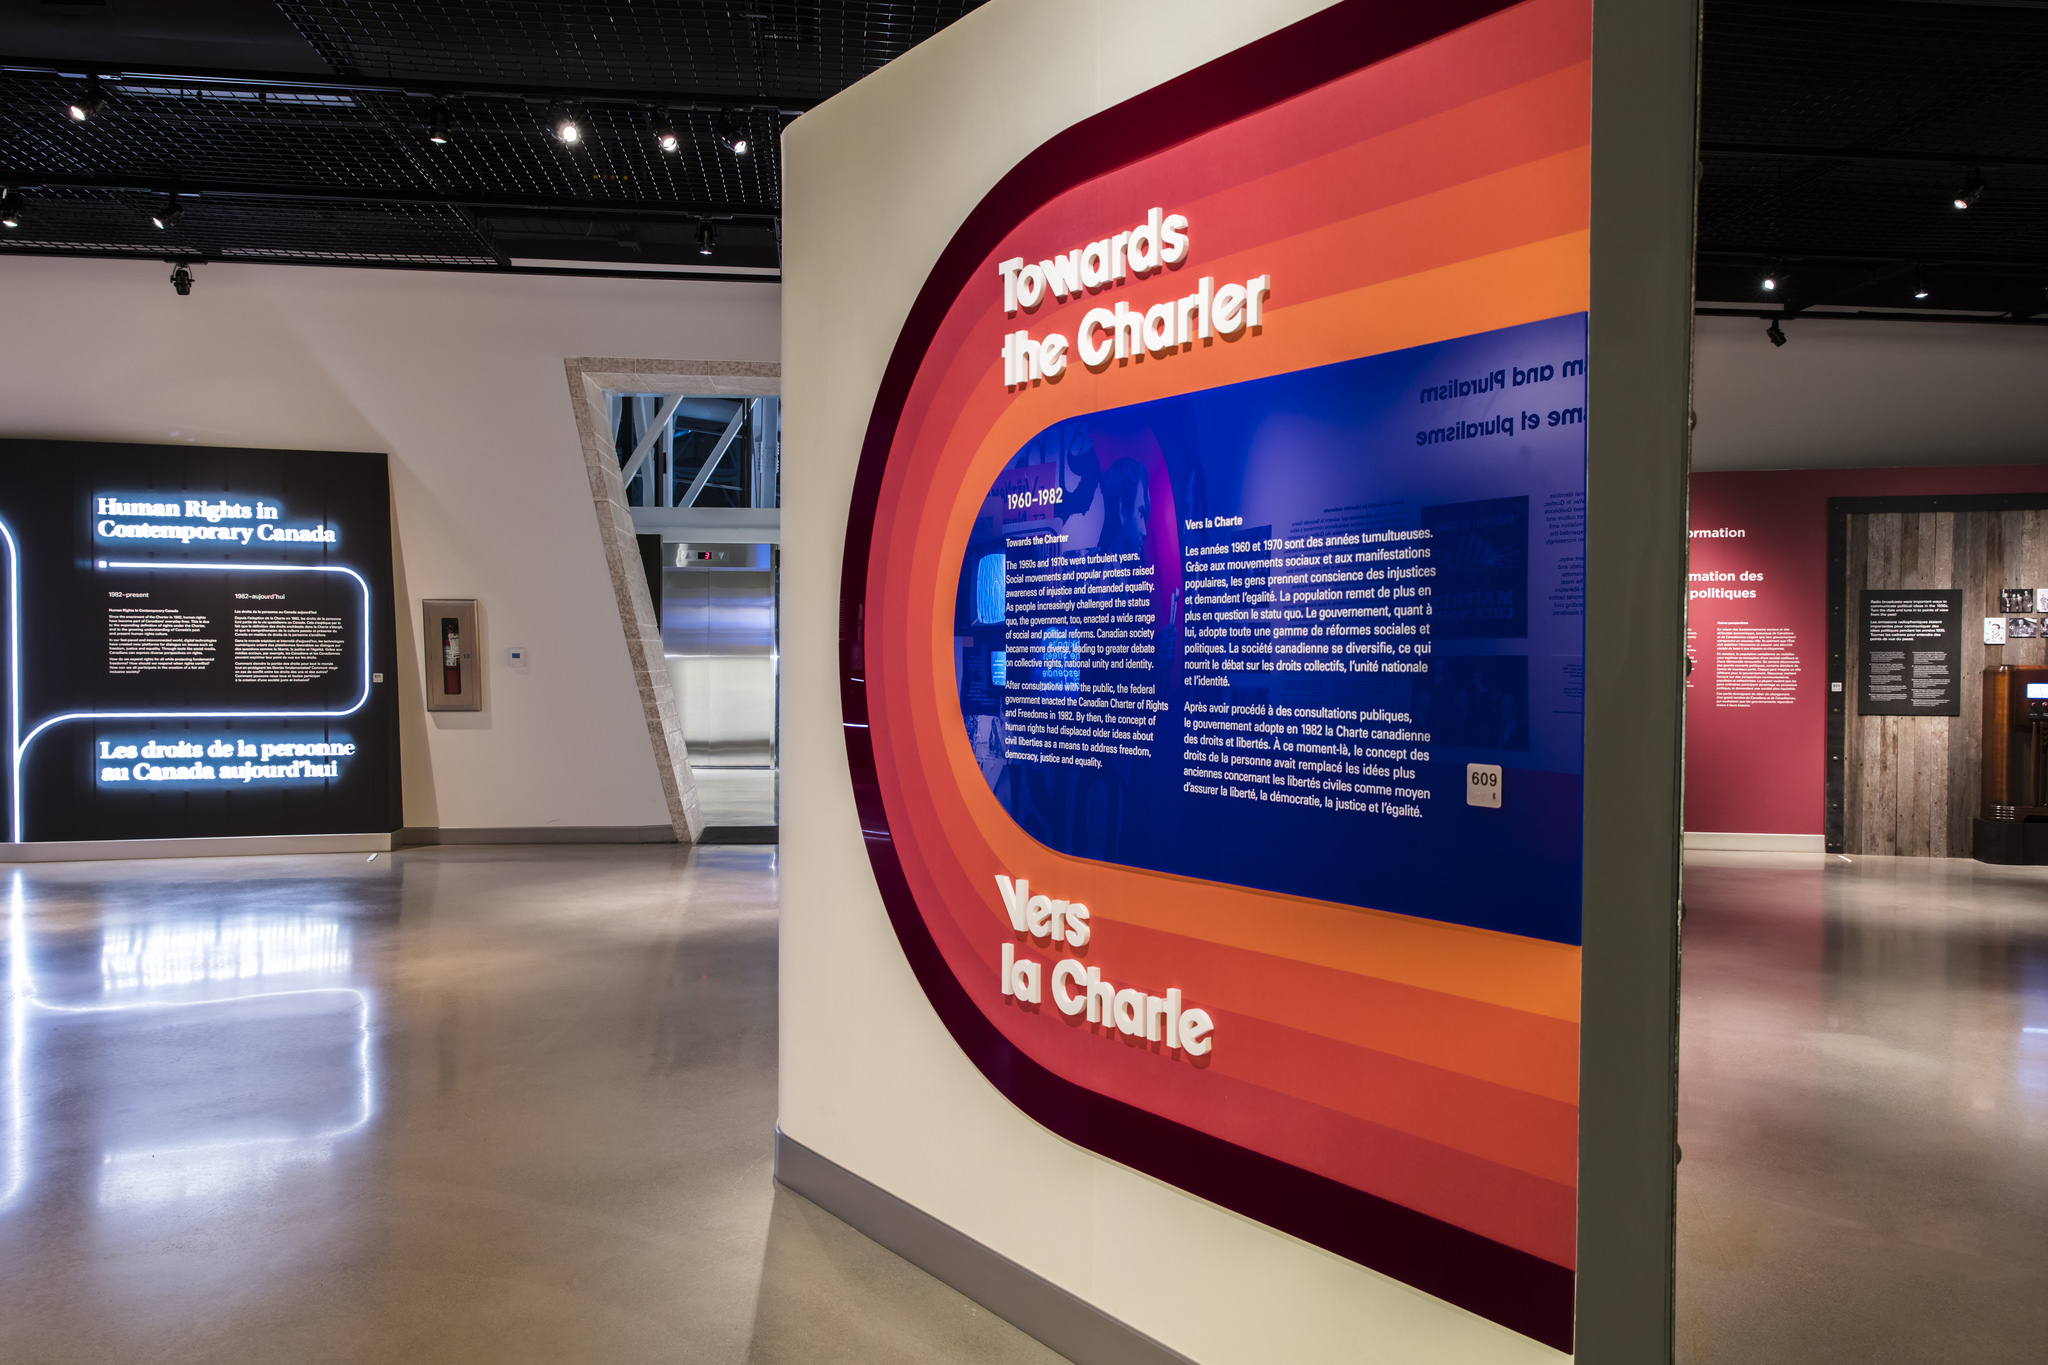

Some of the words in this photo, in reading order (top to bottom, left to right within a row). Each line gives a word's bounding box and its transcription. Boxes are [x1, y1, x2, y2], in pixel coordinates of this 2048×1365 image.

[998, 206, 1189, 313] Towards
[1001, 330, 1069, 386] the
[1077, 274, 1271, 366] Charter
[97, 498, 181, 517] Human
[184, 499, 252, 523] Rights
[255, 501, 279, 520] in
[1185, 519, 1203, 529] Vers
[1205, 518, 1212, 527] la
[1214, 515, 1242, 527] Charte
[97, 520, 254, 545] Contemporary
[256, 523, 337, 543] Canada
[1006, 536, 1031, 547] Towards
[1032, 535, 1043, 544] the
[1044, 534, 1068, 543] Charter
[1185, 546, 1198, 556] Les
[1200, 543, 1228, 554] années
[1231, 541, 1250, 552] 1960
[1252, 541, 1260, 551] et
[1263, 538, 1282, 550] 1970
[1284, 538, 1304, 549] sont
[1306, 536, 1323, 547] des
[1325, 533, 1359, 546] années
[1362, 529, 1432, 543] tumultueuses.
[704, 551, 710, 560] 3
[1006, 560, 1017, 570] The
[1019, 559, 1035, 568] 1960s
[1037, 557, 1049, 567] and
[1051, 556, 1068, 566] 1970s
[1069, 556, 1085, 565] were
[1087, 553, 1117, 563] turbulent
[1119, 553, 1140, 563] years.
[1185, 561, 1208, 572] Grâce
[1210, 562, 1225, 570] aux
[1227, 557, 1283, 569] mouvements
[1285, 554, 1320, 566] sociaux
[1322, 554, 1332, 564] et
[1335, 554, 1352, 563] aux
[1355, 548, 1430, 561] manifestations
[1006, 574, 1023, 584] Social
[1025, 572, 1061, 582] movements
[1062, 570, 1074, 580] and
[1076, 569, 1101, 581] popular
[1102, 568, 1130, 579] protests
[1132, 565, 1154, 575] raised
[1185, 576, 1228, 590] populaires,
[1231, 576, 1242, 586] les
[1244, 577, 1265, 588] gens
[1268, 573, 1308, 586] prennent
[1310, 569, 1363, 582] conscience
[1366, 568, 1384, 579] des
[1387, 566, 1436, 580] injustices
[1739, 570, 1764, 582] des
[1185, 595, 1192, 604] et
[1194, 592, 1240, 604] demandent
[1280, 590, 1290, 601] La
[1293, 588, 1342, 603] population
[1346, 588, 1374, 598] remet
[1377, 586, 1390, 597] de
[1393, 585, 1415, 599] plus
[1418, 586, 1431, 596] en
[1689, 587, 1757, 601] politiques
[1185, 610, 1200, 622] plus
[1202, 612, 1212, 620] en
[1214, 609, 1248, 622] question
[1251, 608, 1258, 619] le
[1260, 609, 1281, 619] statu
[1284, 610, 1303, 620] quo.
[1306, 607, 1317, 618] Le
[1319, 606, 1391, 620] gouvernement,
[1394, 605, 1423, 618] quant
[1426, 603, 1432, 614] à
[1005, 696, 1040, 704] government
[1041, 696, 1065, 705] enacted
[1066, 696, 1077, 706] the
[1078, 696, 1108, 707] Canadian
[1110, 698, 1135, 708] Charter
[1136, 699, 1144, 709] of
[1146, 699, 1168, 712] Rights
[1005, 708, 1016, 717] and
[1018, 708, 1048, 719] Freedoms
[1050, 710, 1055, 719] in
[1058, 710, 1074, 720] 1982.
[1076, 711, 1084, 722] By
[1086, 712, 1103, 723] then,
[1105, 713, 1116, 723] the
[1118, 716, 1146, 726] concept
[1148, 715, 1156, 725] of
[1005, 721, 1025, 731] human
[1027, 723, 1044, 734] rights
[1046, 724, 1058, 734] had
[1060, 725, 1090, 736] displaced
[1092, 728, 1110, 737] older
[1112, 728, 1130, 739] ideas
[1132, 730, 1153, 741] about
[99, 741, 138, 760] Les
[141, 740, 204, 759] droits
[207, 739, 235, 758] de
[236, 739, 258, 758] la
[260, 742, 356, 762] personne
[101, 765, 130, 781] au
[132, 761, 216, 781] Canada
[1471, 771, 1498, 787] 609
[1220, 785, 1227, 796] la
[1230, 786, 1257, 800] liberté,
[1260, 789, 1267, 800] la
[1269, 790, 1322, 807] démocratie,
[1325, 796, 1332, 807] la
[1335, 797, 1366, 811] justice
[1368, 802, 1378, 813] et
[994, 874, 1091, 947] Vers
[1001, 942, 1042, 1004] la
[1051, 958, 1215, 1056] Charte
